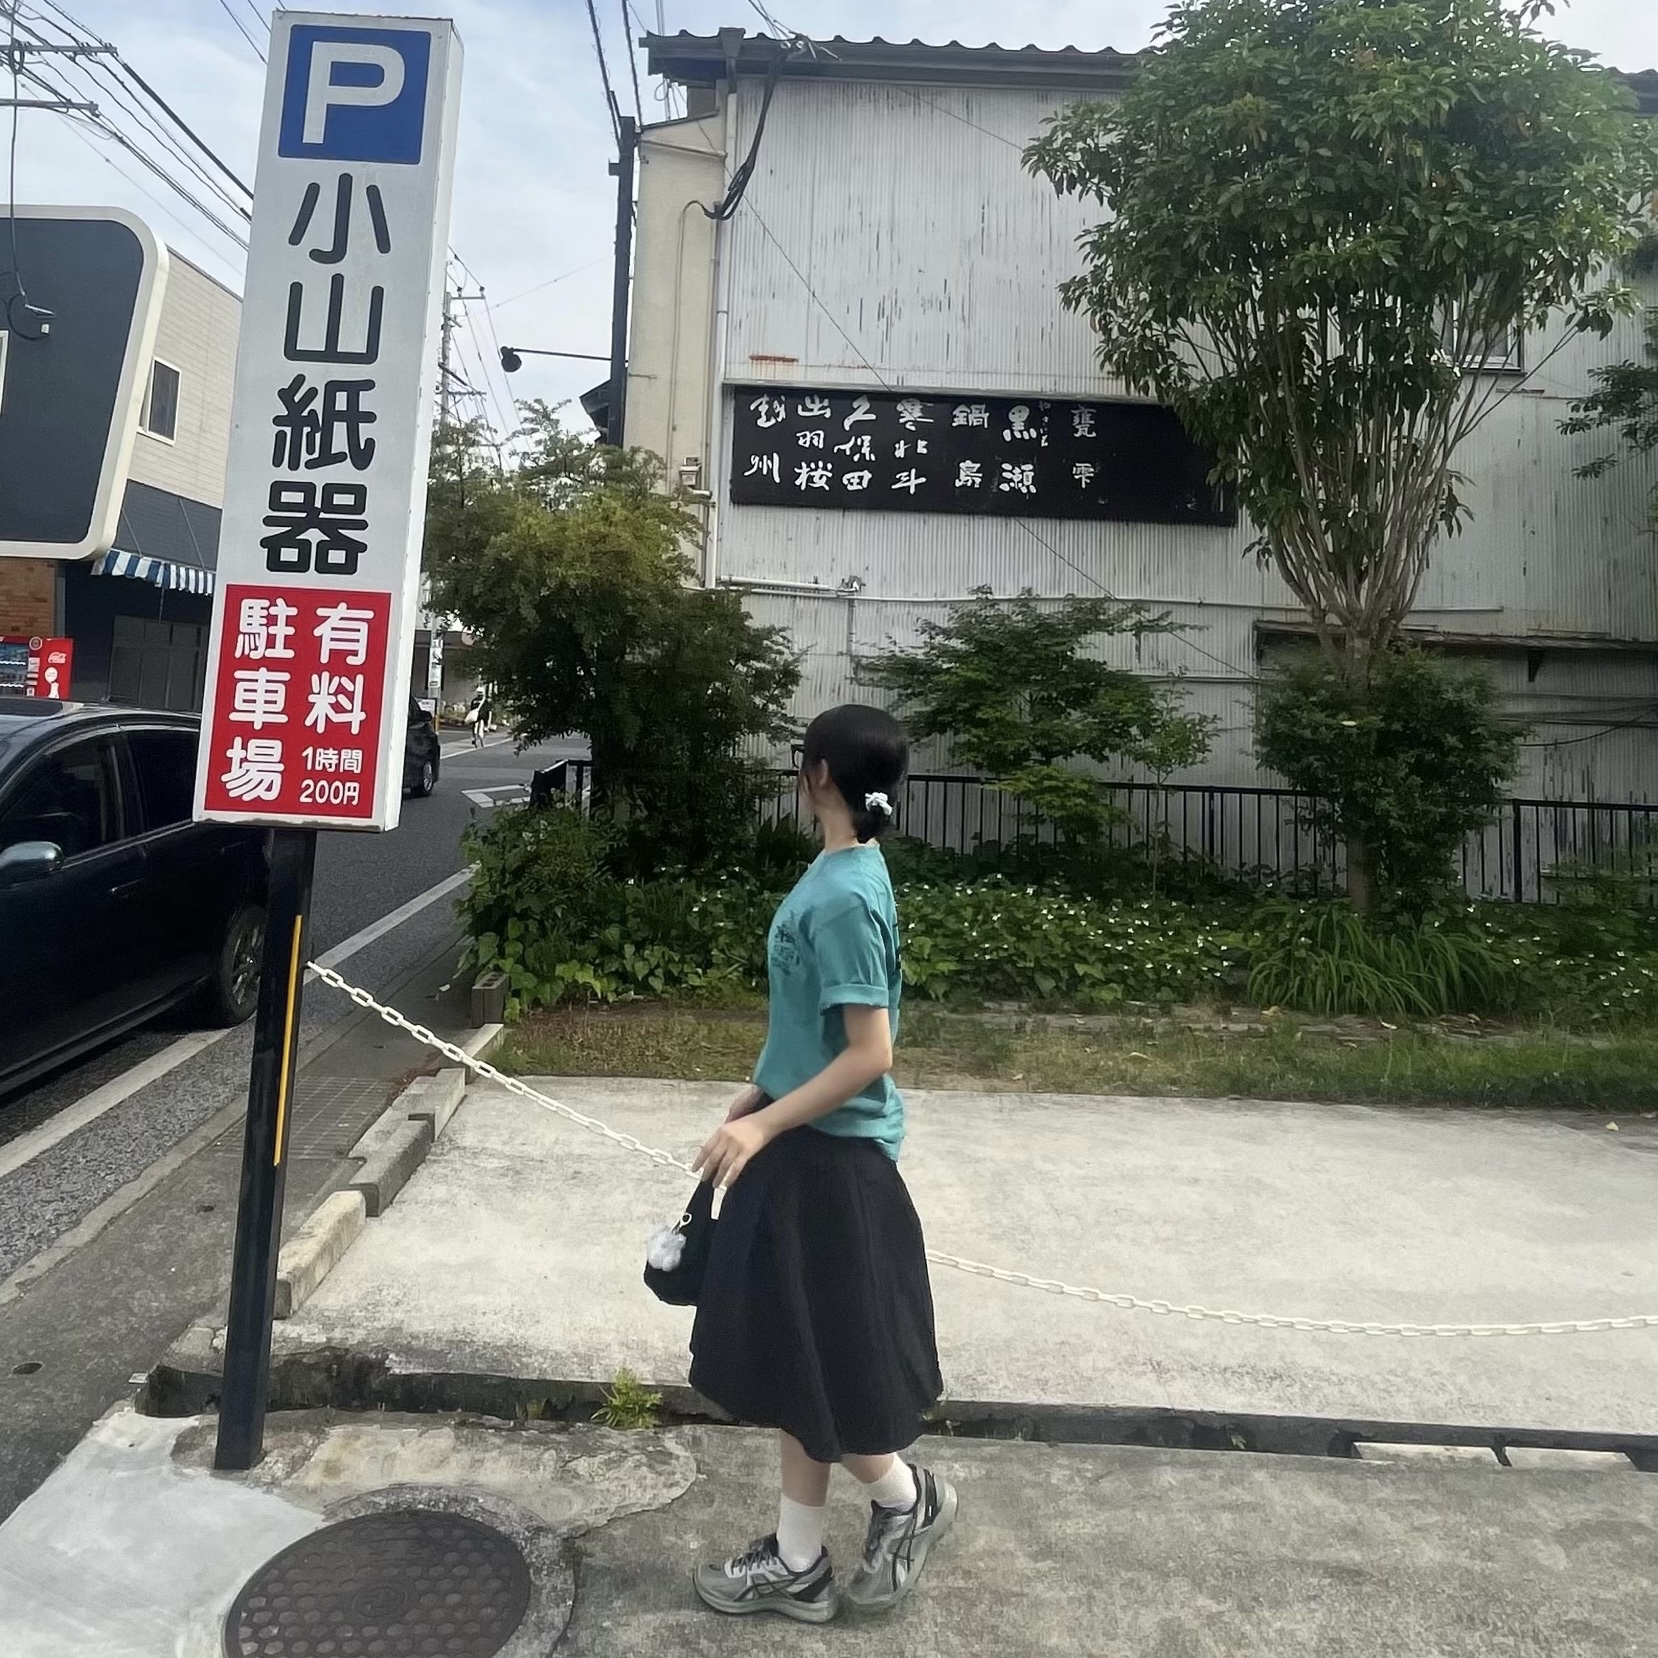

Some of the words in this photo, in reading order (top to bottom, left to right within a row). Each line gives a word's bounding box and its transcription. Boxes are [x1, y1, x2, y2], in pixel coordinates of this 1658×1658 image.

[302, 41, 406, 144] P
[260, 172, 391, 575] 小山紙器
[794, 394, 833, 490] 出羽桜
[834, 395, 877, 490] 久保田
[891, 398, 934, 494] 寒北斗
[952, 403, 989, 488] 鍋島
[999, 405, 1037, 494] 黒瀬
[221, 597, 299, 802] 駐車場
[304, 602, 375, 735] 有料
[299, 779, 360, 806] 200円
[301, 746, 363, 773] 1時間
